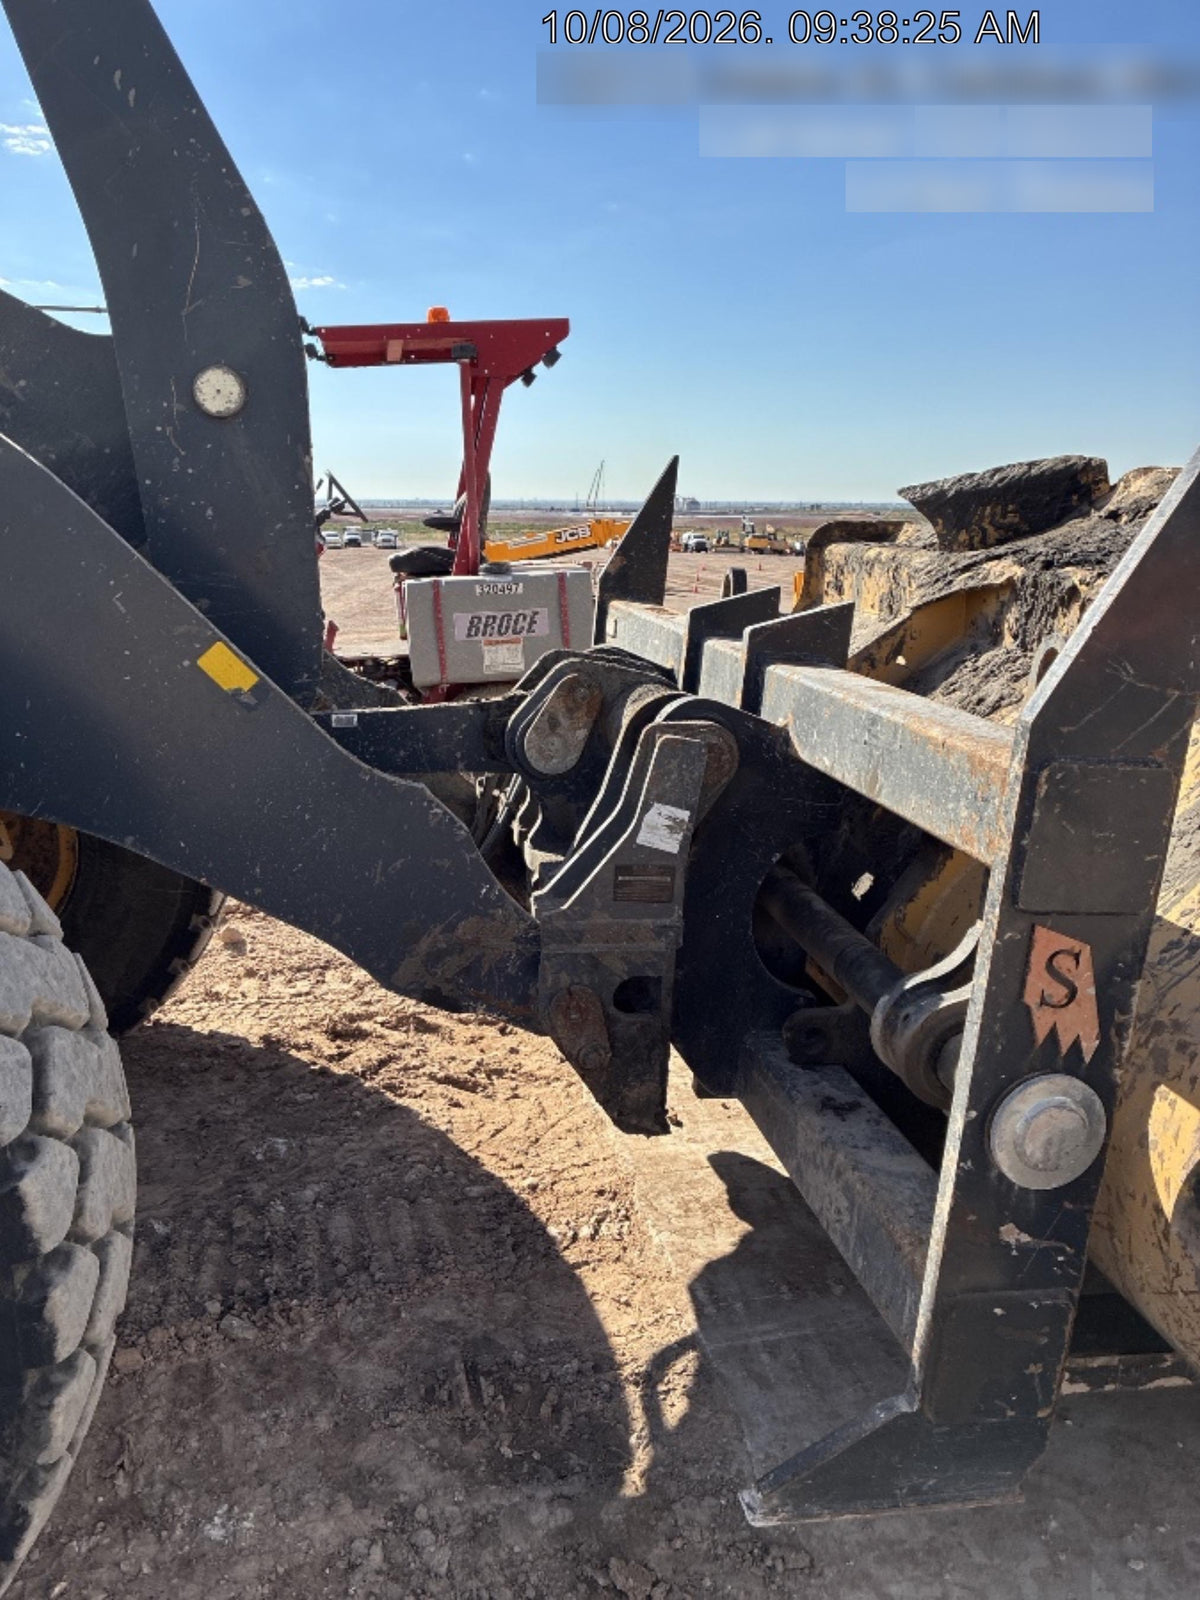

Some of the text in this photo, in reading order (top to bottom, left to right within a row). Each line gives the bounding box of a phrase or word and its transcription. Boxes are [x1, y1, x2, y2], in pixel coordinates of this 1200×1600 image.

[555, 524, 592, 544] JCB
[465, 610, 540, 639] BROCE
[1040, 948, 1082, 1009] S
